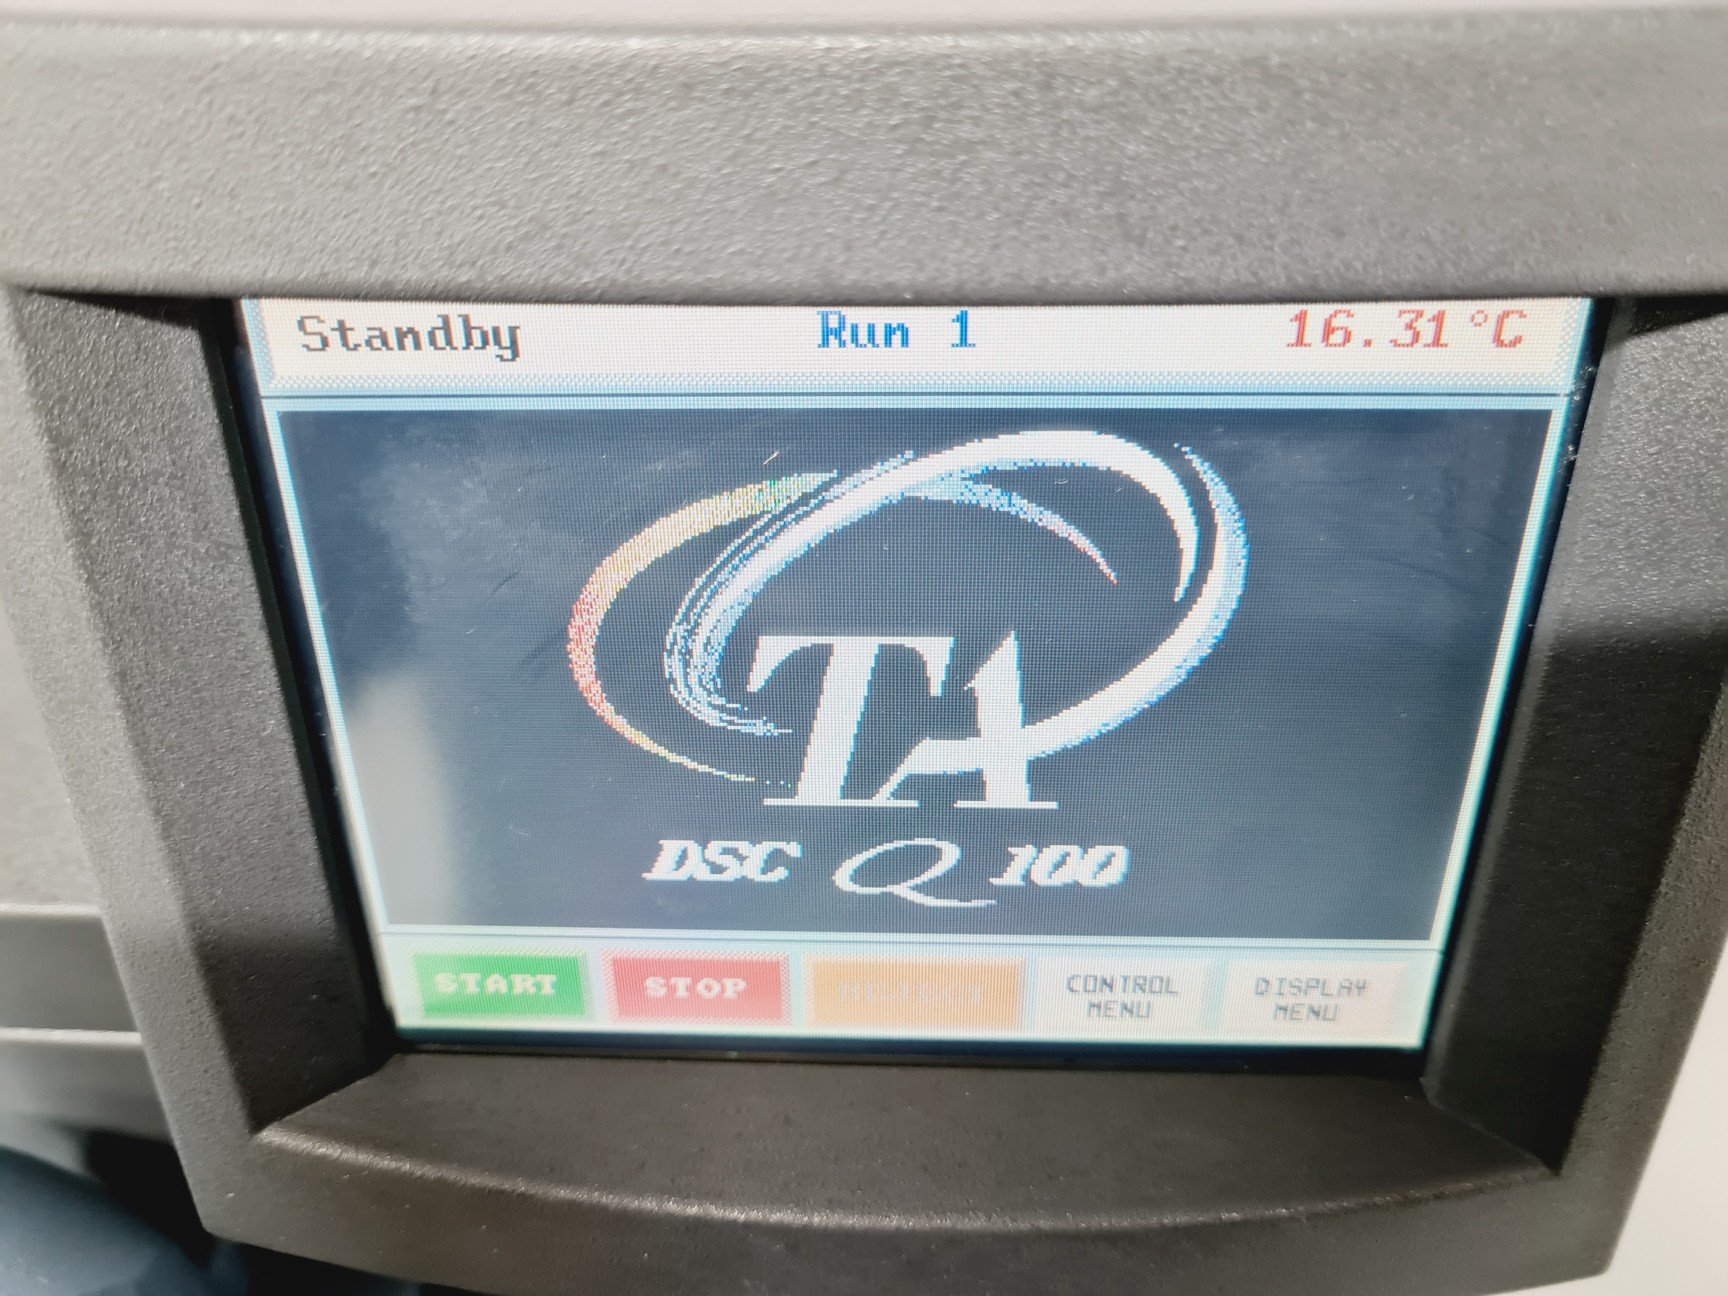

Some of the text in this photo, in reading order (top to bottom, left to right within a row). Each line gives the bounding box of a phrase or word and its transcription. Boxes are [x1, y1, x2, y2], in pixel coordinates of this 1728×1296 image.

[298, 314, 522, 362] Standby
[817, 309, 978, 348] Run 1
[642, 837, 1131, 908] DSC Q 100
[435, 971, 558, 996] START
[644, 975, 747, 1001] STOP
[1066, 974, 1179, 997] CONTROL
[1254, 976, 1368, 1000] DISPLAY
[1086, 1000, 1152, 1022] MENU
[1272, 1003, 1338, 1025] MENU
